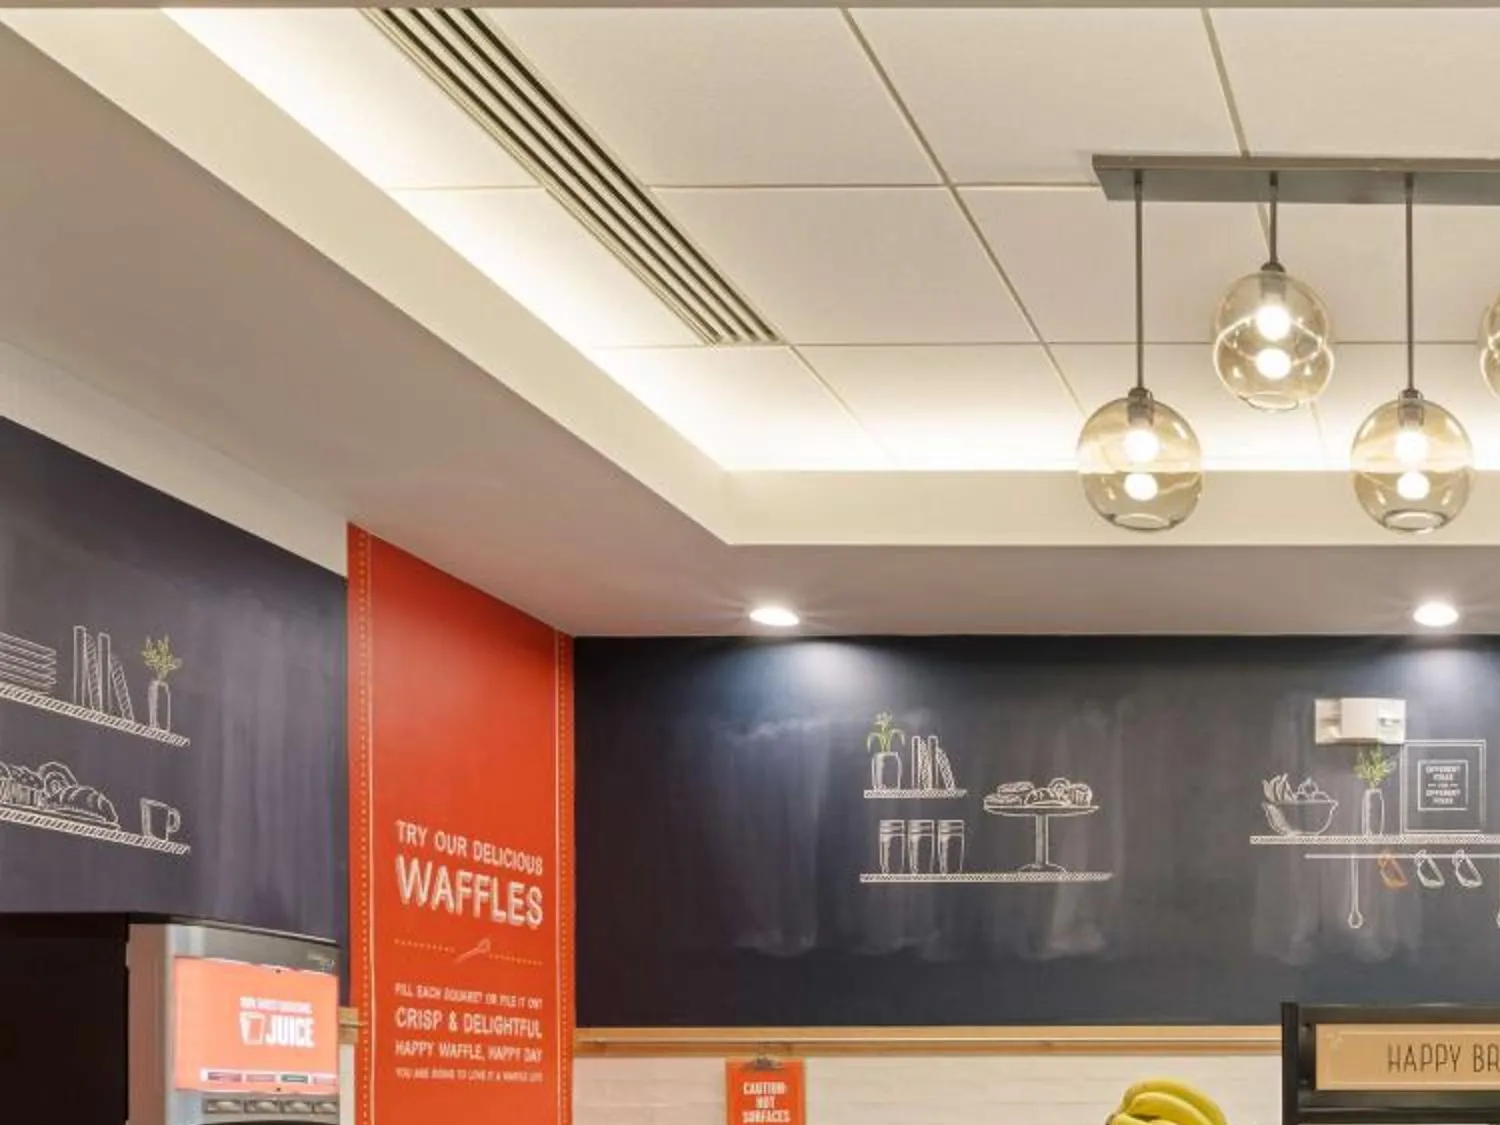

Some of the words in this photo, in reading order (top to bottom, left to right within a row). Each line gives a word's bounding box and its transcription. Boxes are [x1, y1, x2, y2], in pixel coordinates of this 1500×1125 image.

[394, 819, 428, 848] TRY
[434, 831, 467, 857] OUR
[473, 840, 543, 876] DELICIOUS
[395, 854, 543, 930] WAFFLES
[265, 1014, 315, 1048] JUICE
[394, 1005, 442, 1030] CRISP
[448, 1010, 458, 1032] &
[463, 1012, 543, 1039] DELIGHTFUL
[395, 1039, 434, 1057] HAPPY
[488, 1045, 521, 1061] HAPPY
[1387, 1043, 1461, 1073] HAPPY
[742, 1109, 791, 1124] SURFACES
